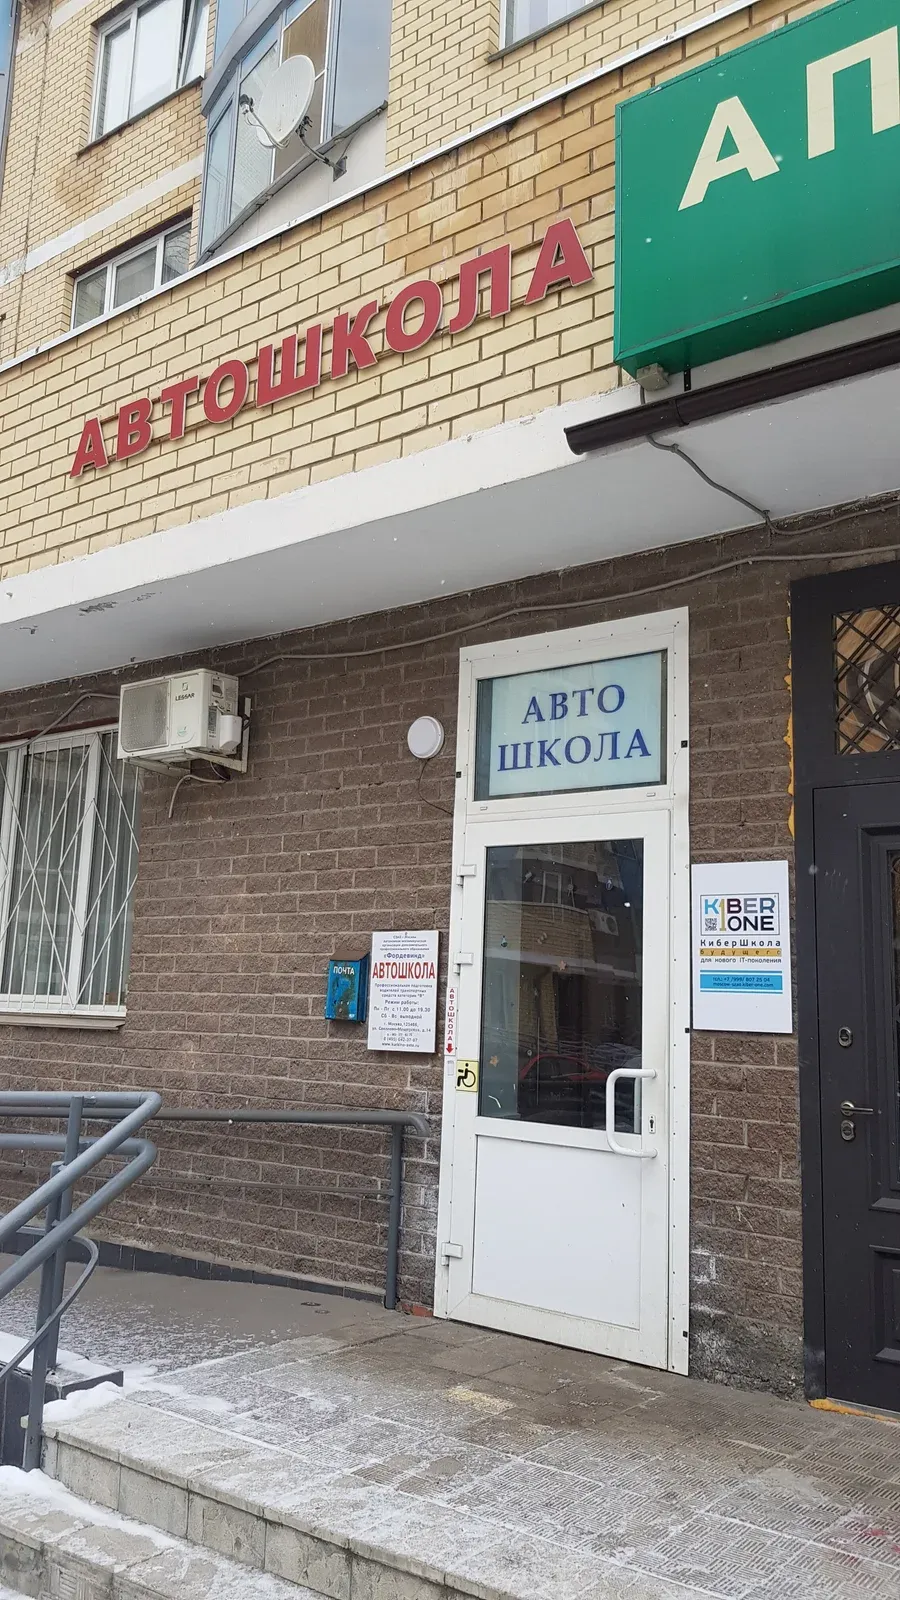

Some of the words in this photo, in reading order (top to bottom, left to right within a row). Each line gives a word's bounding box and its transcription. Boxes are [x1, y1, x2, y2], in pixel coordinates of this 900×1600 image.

[69, 217, 595, 479] АВТОШКОЛА
[175, 693, 195, 701] LESSAR
[521, 684, 625, 724] АВТО
[497, 728, 652, 771] ШКОЛА
[727, 915, 775, 931] ONE
[700, 939, 781, 948] КиберШкола
[333, 966, 355, 975] ПОЧТА
[372, 961, 436, 979] АВТОШКОЛА
[447, 988, 455, 1041] АВТОШКОЛА
